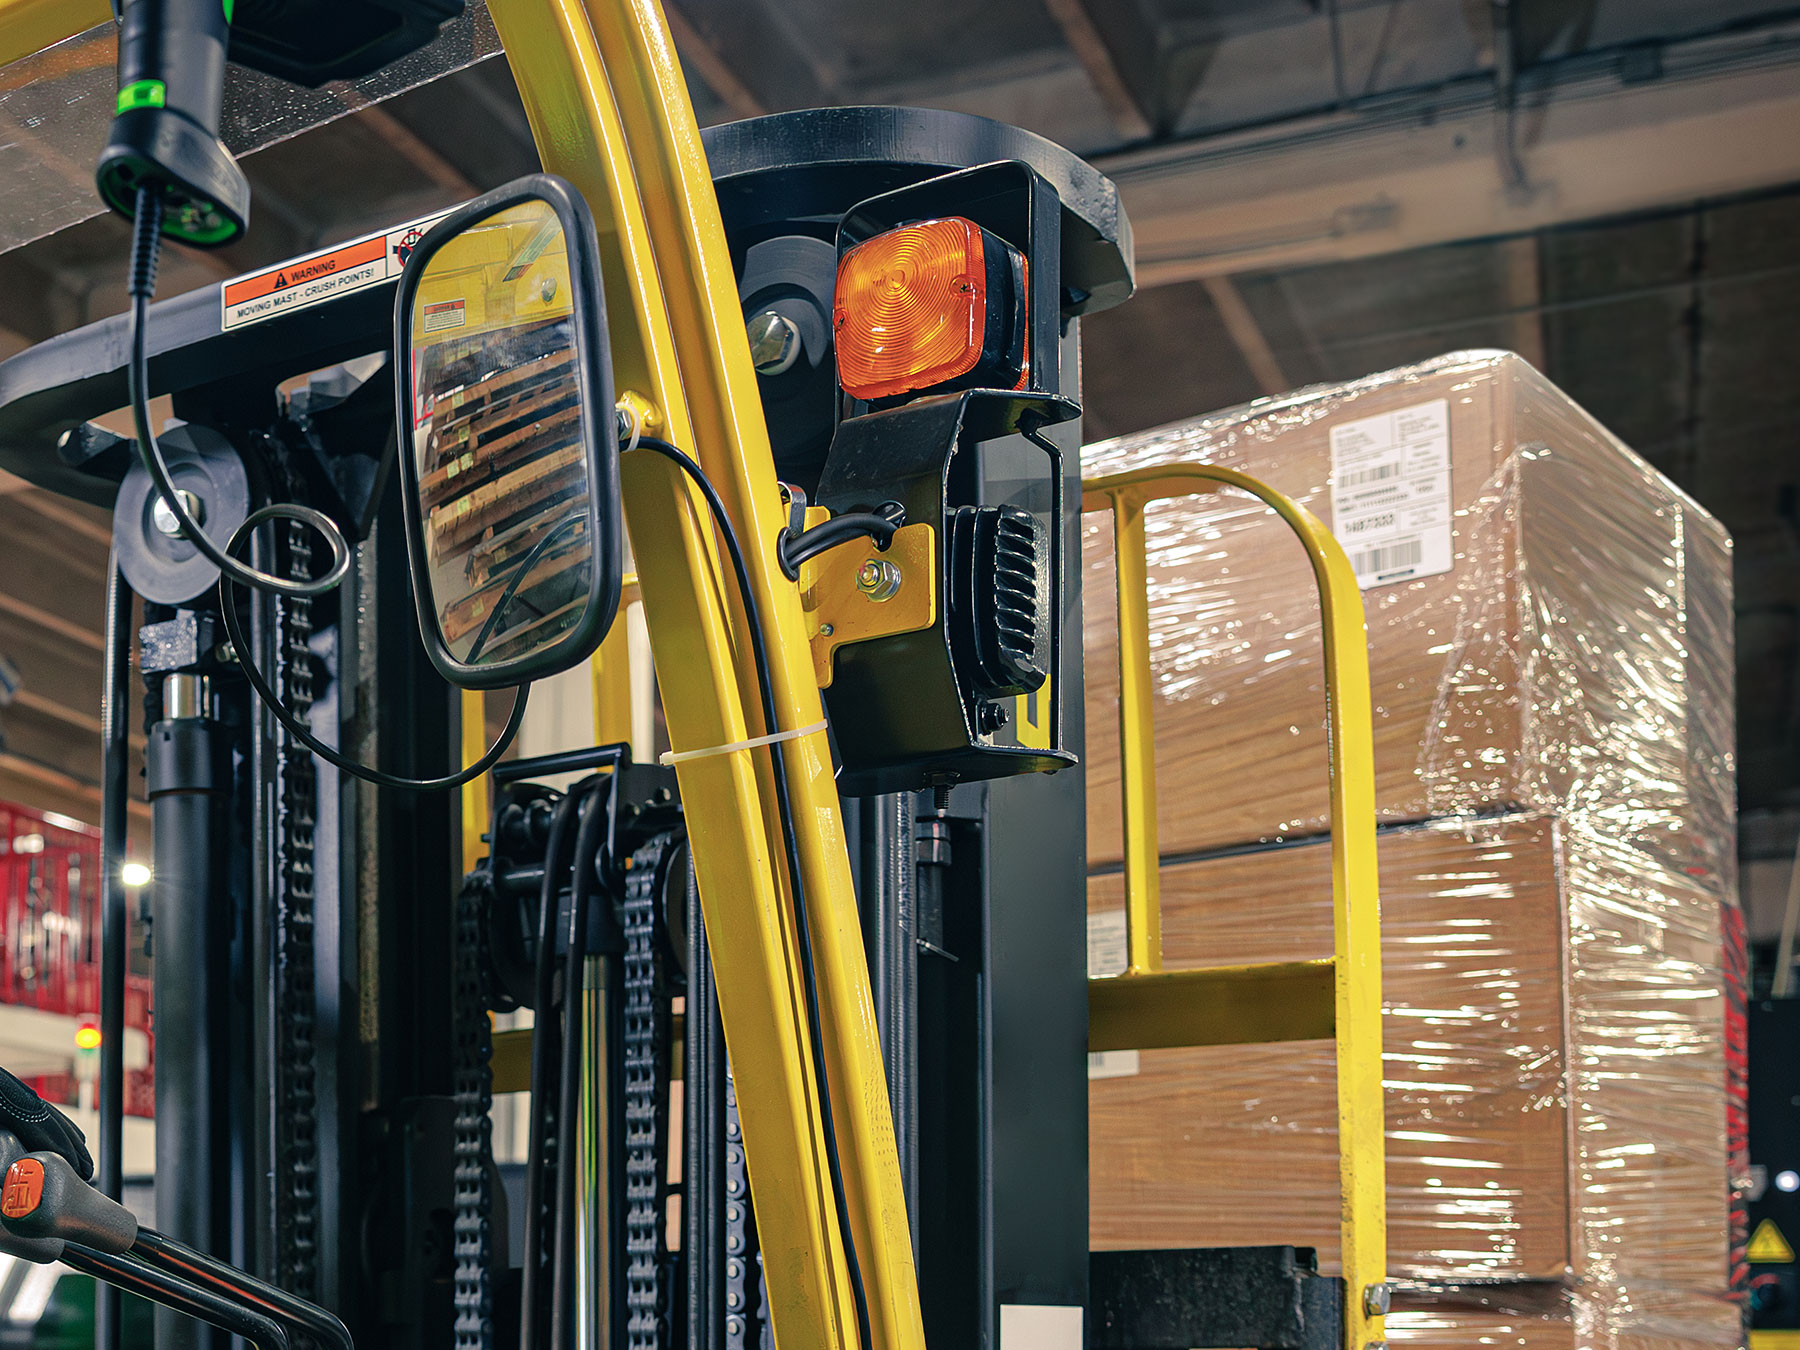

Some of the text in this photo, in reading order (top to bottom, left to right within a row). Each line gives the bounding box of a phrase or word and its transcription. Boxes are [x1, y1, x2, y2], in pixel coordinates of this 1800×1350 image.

[291, 260, 336, 282] WARNING
[236, 301, 271, 318] MOVING
[273, 293, 298, 308] MAST
[305, 282, 337, 298] CRUSH
[338, 268, 375, 288] POINTS!
